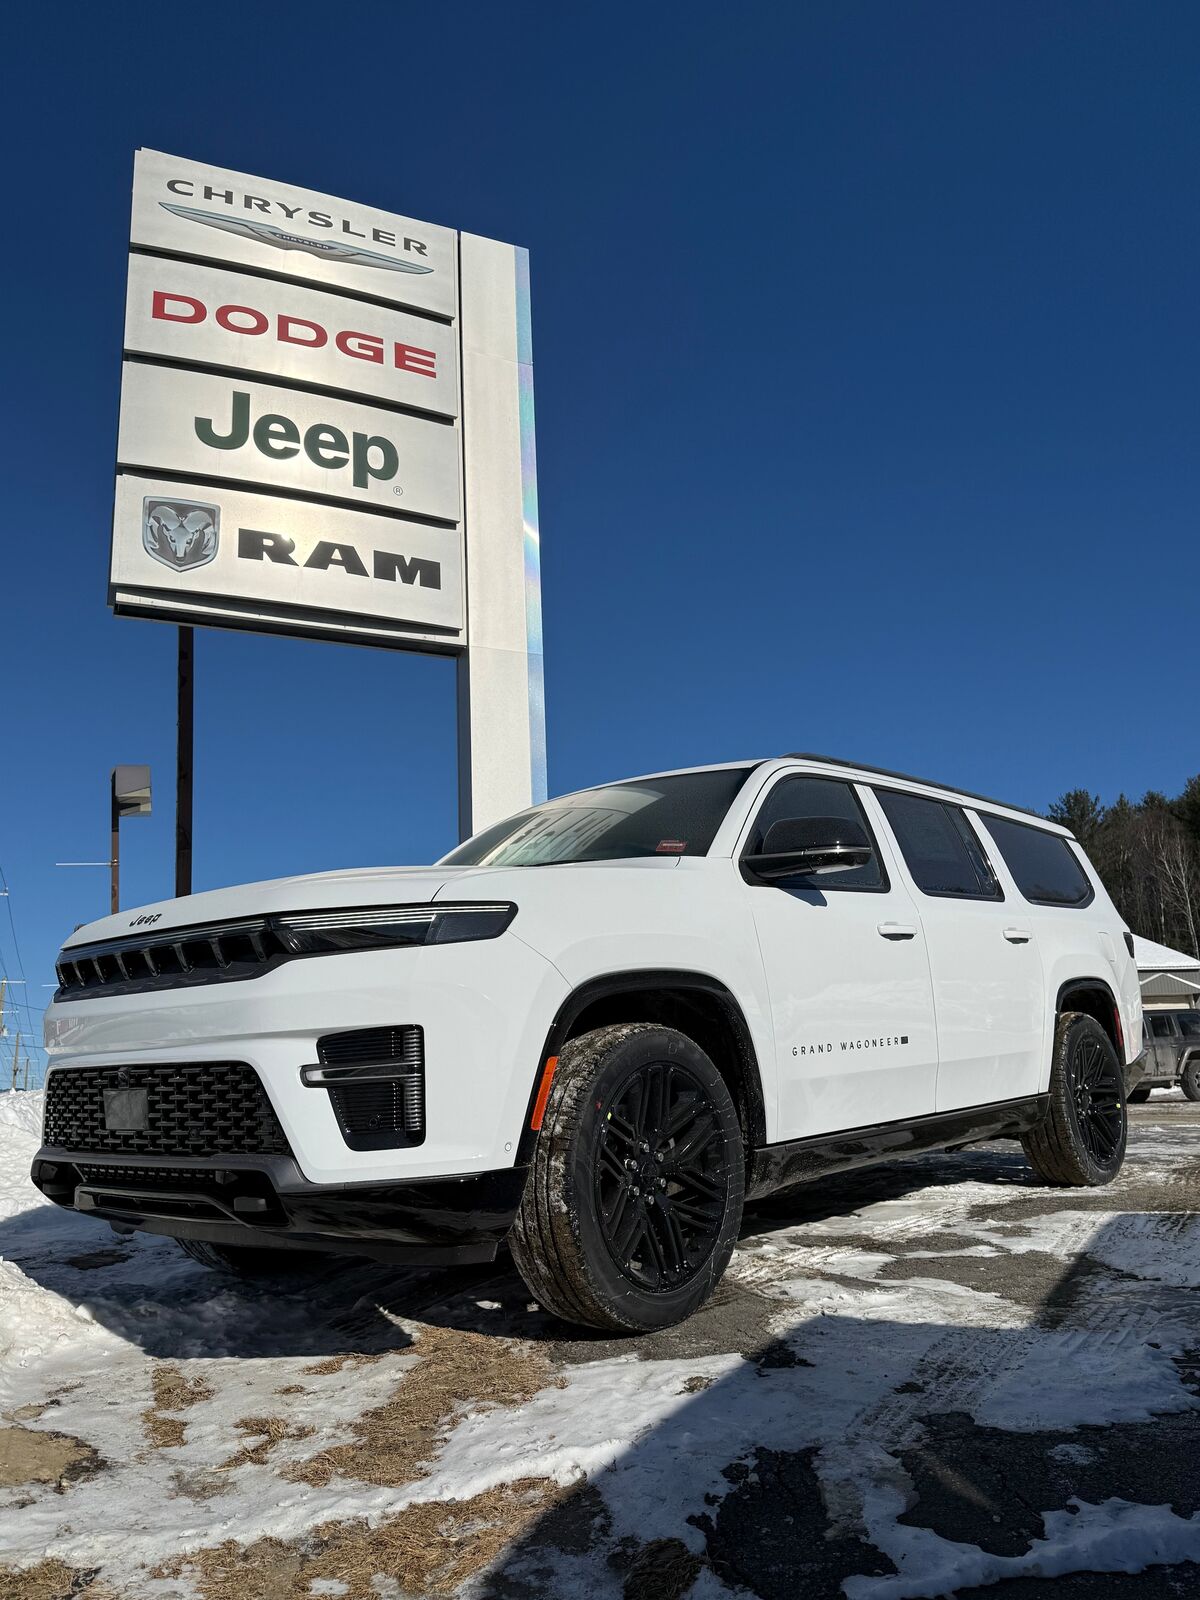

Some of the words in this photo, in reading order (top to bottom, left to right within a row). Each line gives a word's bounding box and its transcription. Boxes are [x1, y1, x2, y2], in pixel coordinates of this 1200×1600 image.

[166, 179, 429, 256] CHRYSLER
[151, 290, 437, 378] DODGE
[194, 390, 399, 489] Jeep
[238, 527, 441, 590] RAM
[129, 913, 162, 927] Jeep
[792, 1043, 833, 1056] GRAND
[840, 1037, 899, 1050] WAGONEER
